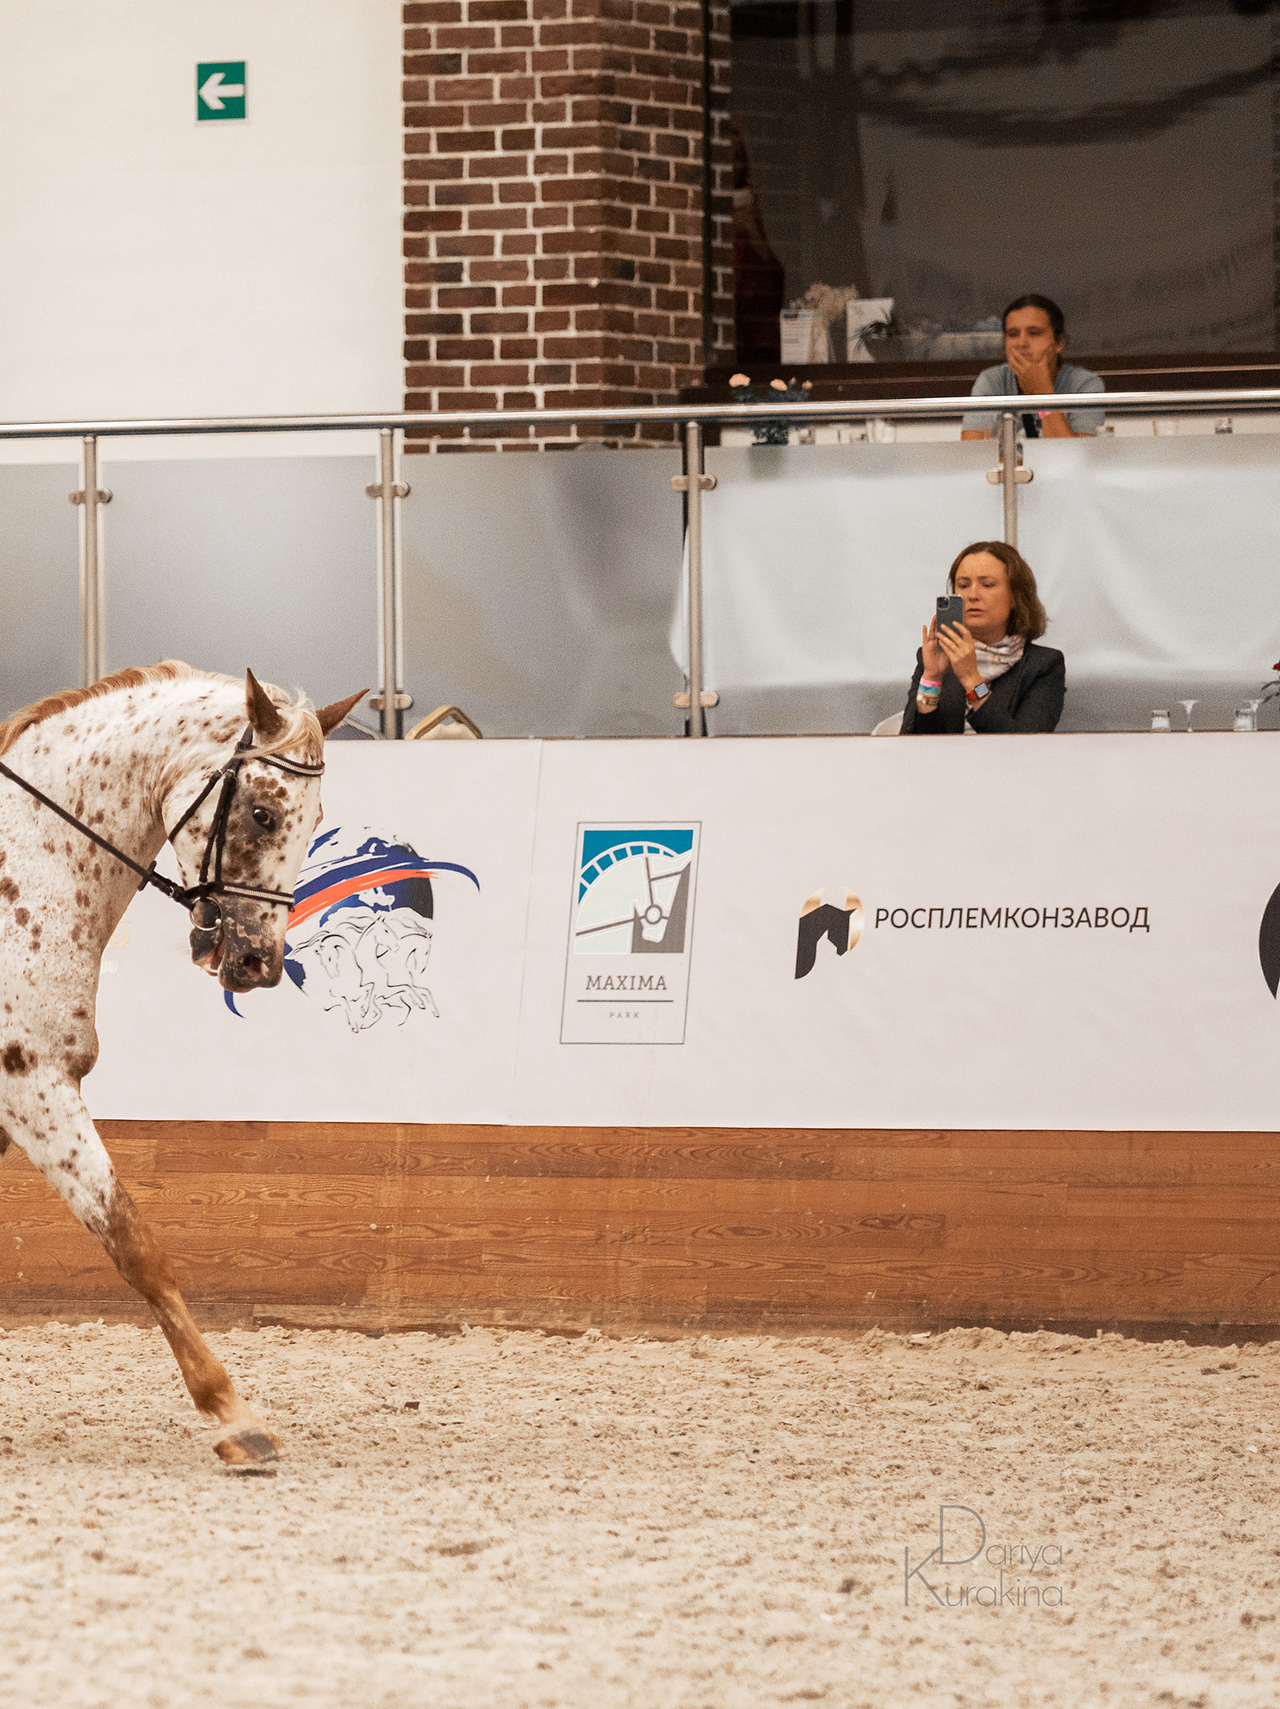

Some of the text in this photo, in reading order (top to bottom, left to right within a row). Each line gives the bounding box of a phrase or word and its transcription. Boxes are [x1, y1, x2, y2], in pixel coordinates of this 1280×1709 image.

[874, 906, 1150, 933] РОСПЛЕМКОНЗАВОД
[585, 975, 667, 991] MAXIMA
[609, 1011, 640, 1019] PARK
